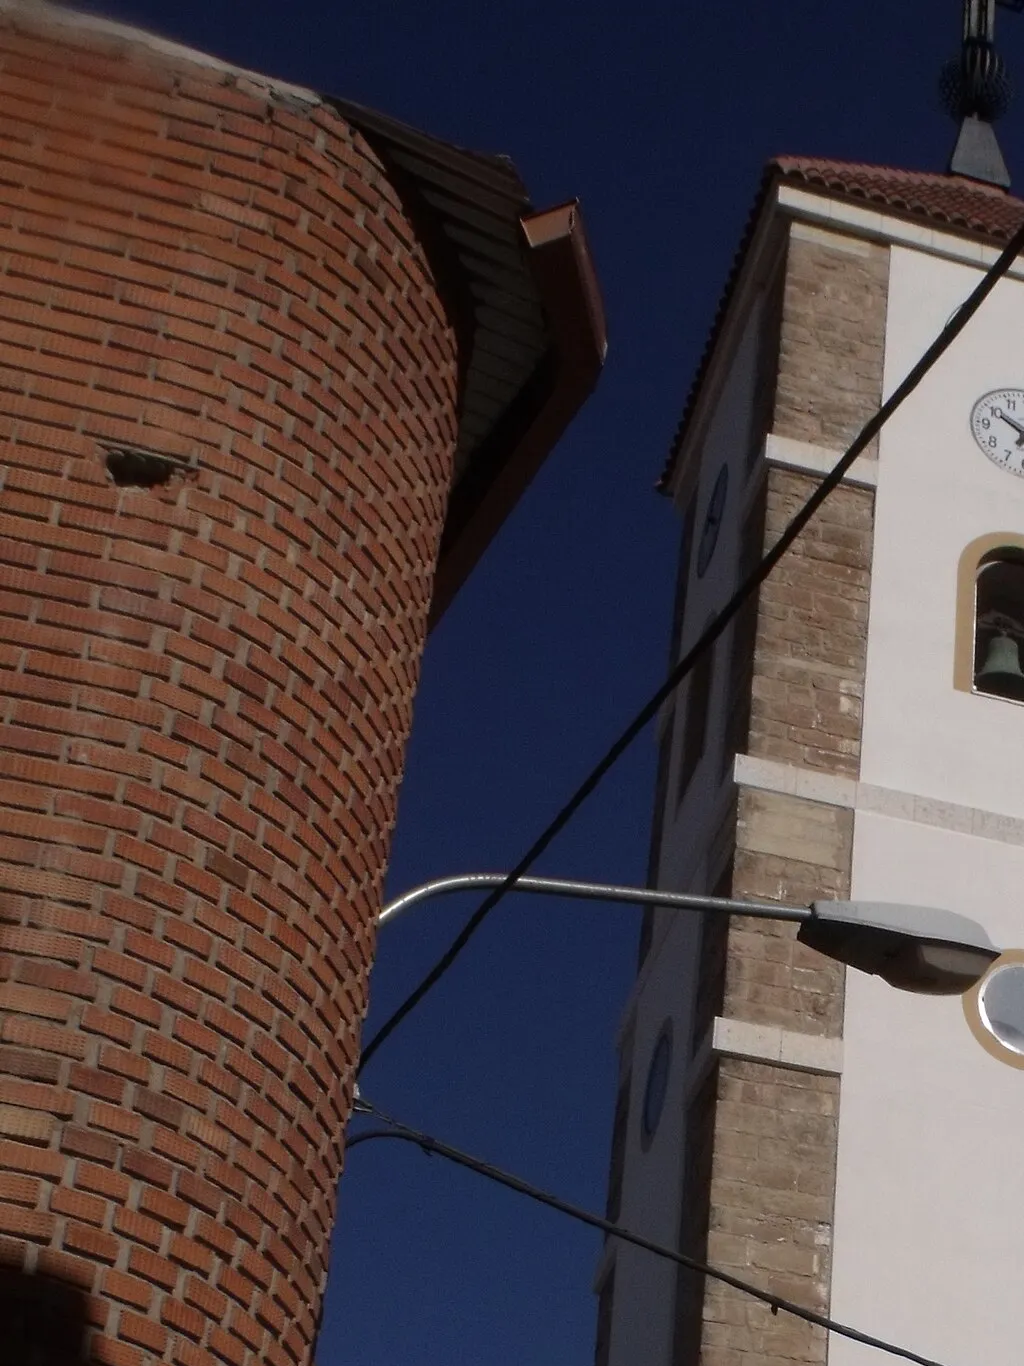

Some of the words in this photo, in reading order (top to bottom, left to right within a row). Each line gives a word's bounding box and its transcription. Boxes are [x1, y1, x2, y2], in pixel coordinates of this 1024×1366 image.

[1007, 399, 1016, 411] 11
[990, 406, 1003, 418] 10
[981, 418, 991, 430] 9
[988, 436, 997, 448] 8
[1003, 449, 1012, 461] 7
